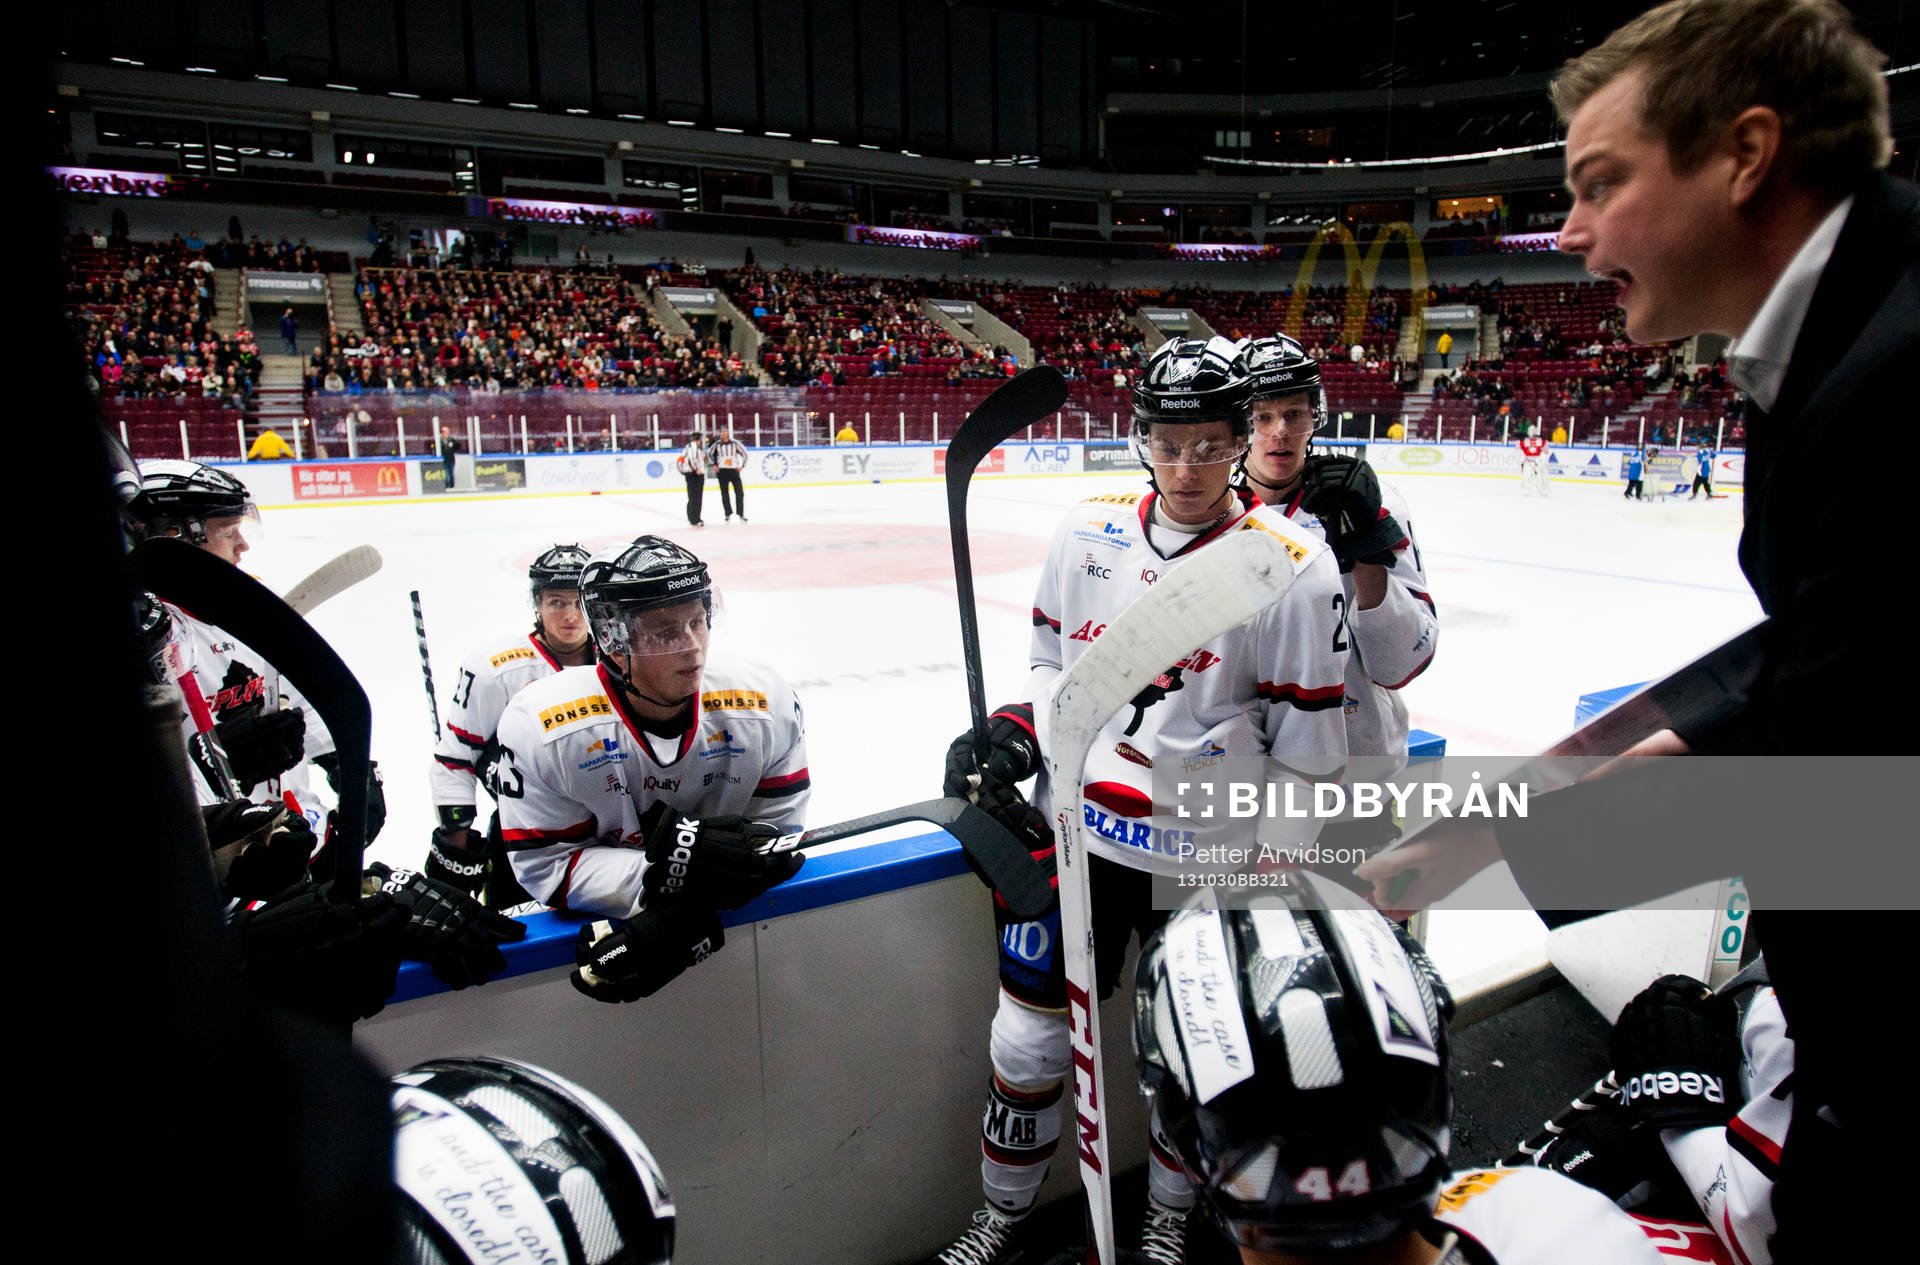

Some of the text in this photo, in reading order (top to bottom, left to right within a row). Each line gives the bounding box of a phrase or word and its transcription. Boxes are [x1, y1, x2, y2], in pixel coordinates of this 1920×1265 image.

[856, 227, 980, 250] Powerbreak
[1168, 385, 1192, 393] hbc.se
[1259, 371, 1294, 385] Reebok
[1160, 399, 1201, 410] Reebok
[842, 453, 871, 475] EY
[551, 573, 580, 582] Reebok
[667, 574, 702, 591] Reebok
[1087, 564, 1112, 580] RCC
[702, 697, 767, 710] PONSSE
[543, 702, 611, 730] PONSSE
[643, 775, 681, 793] IQuity
[431, 844, 485, 877] Reebok
[659, 816, 701, 894] Reebok
[597, 943, 628, 966] Reebok
[1211, 1018, 1242, 1072] case
[1066, 977, 1103, 1177] CCM
[1619, 1071, 1726, 1107] Reebok
[1009, 1115, 1037, 1144] AB
[1562, 1149, 1595, 1174] Reebok
[1295, 1157, 1372, 1202] 44
